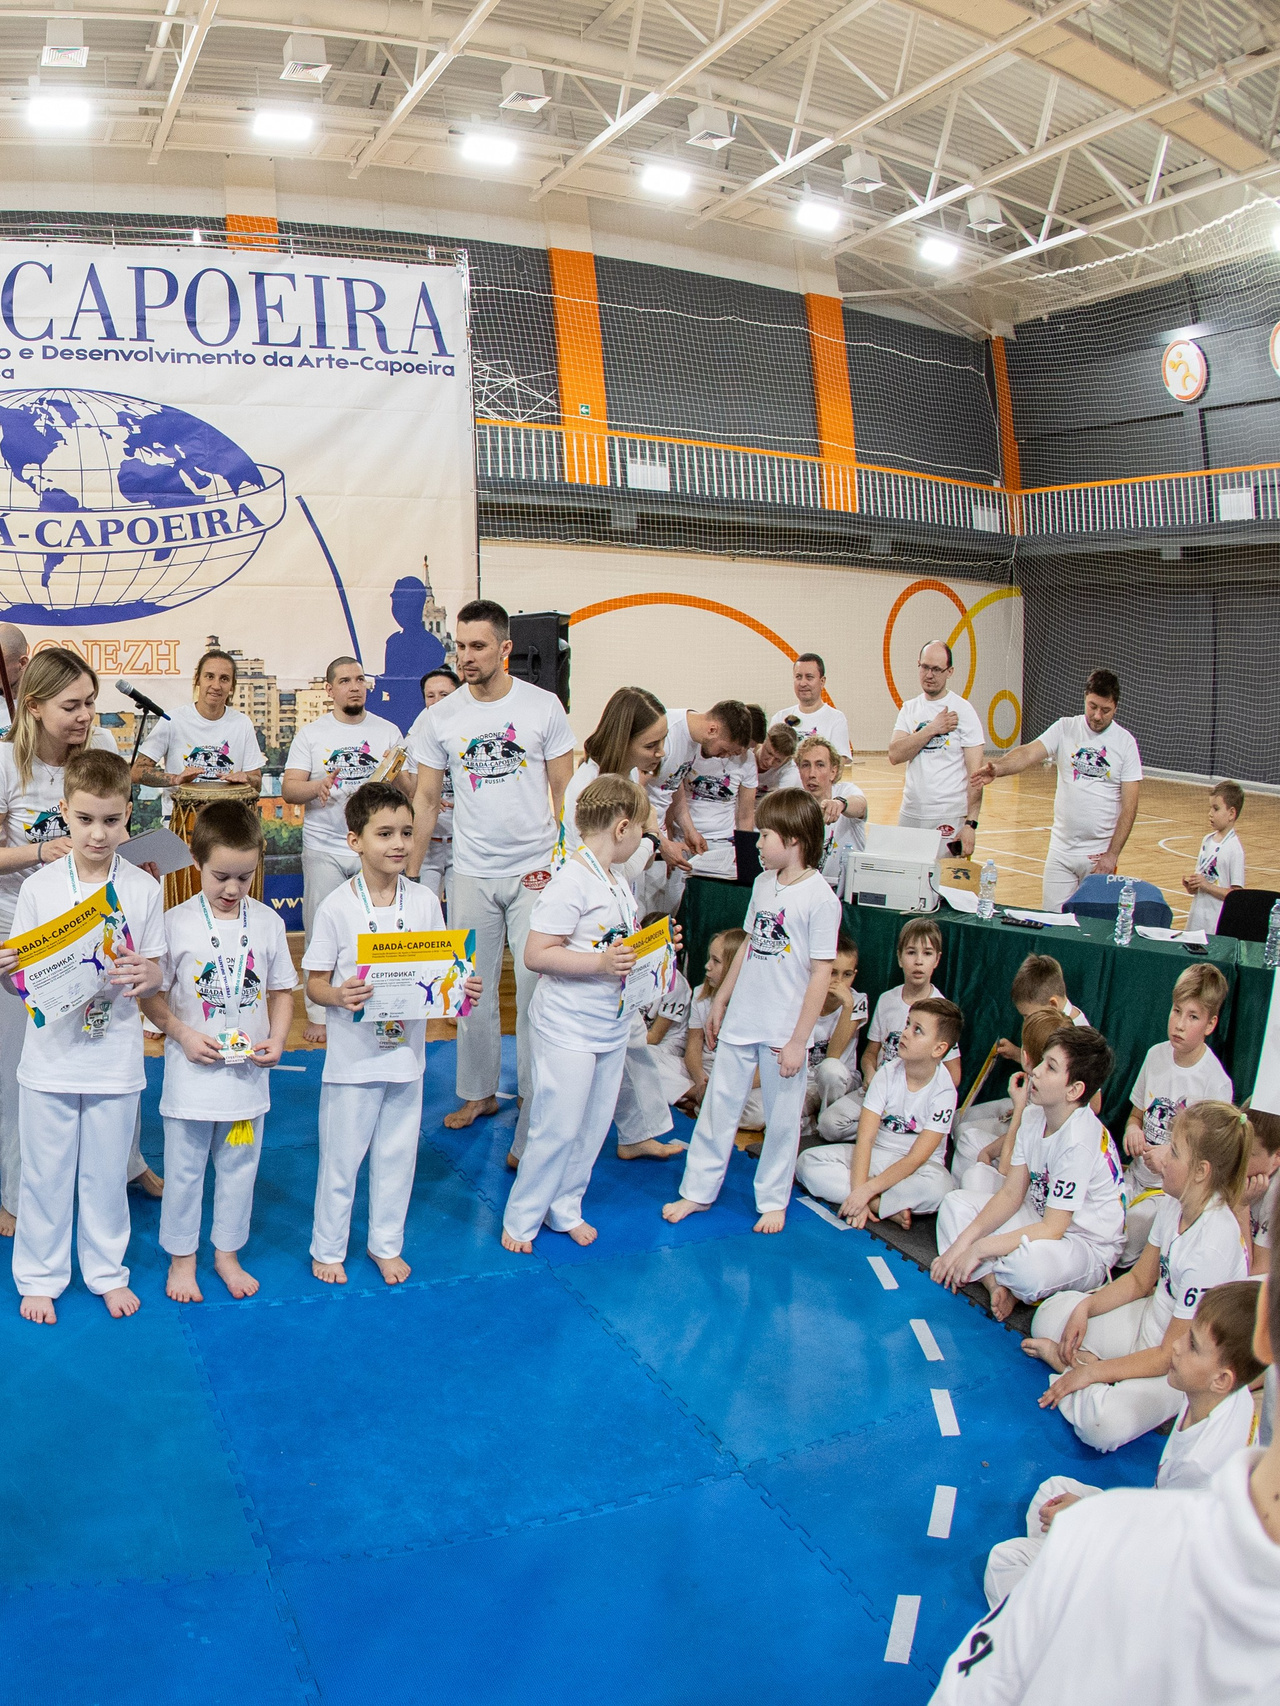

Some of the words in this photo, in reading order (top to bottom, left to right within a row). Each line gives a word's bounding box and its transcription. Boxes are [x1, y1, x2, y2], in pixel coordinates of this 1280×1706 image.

[19, 347, 34, 359] e
[42, 345, 256, 366] Desenvolvimento
[263, 350, 293, 367] da
[297, 355, 455, 377] Arte-Capoeira
[17, 906, 97, 956] ABADÁ-CAPOEIRA
[372, 940, 452, 951] ABADÁ-CAPOEIRA
[28, 953, 76, 981] СЕРТИФИКАТ
[371, 971, 416, 979] СЕРТИФИКАТ
[1053, 1179, 1076, 1199] 52
